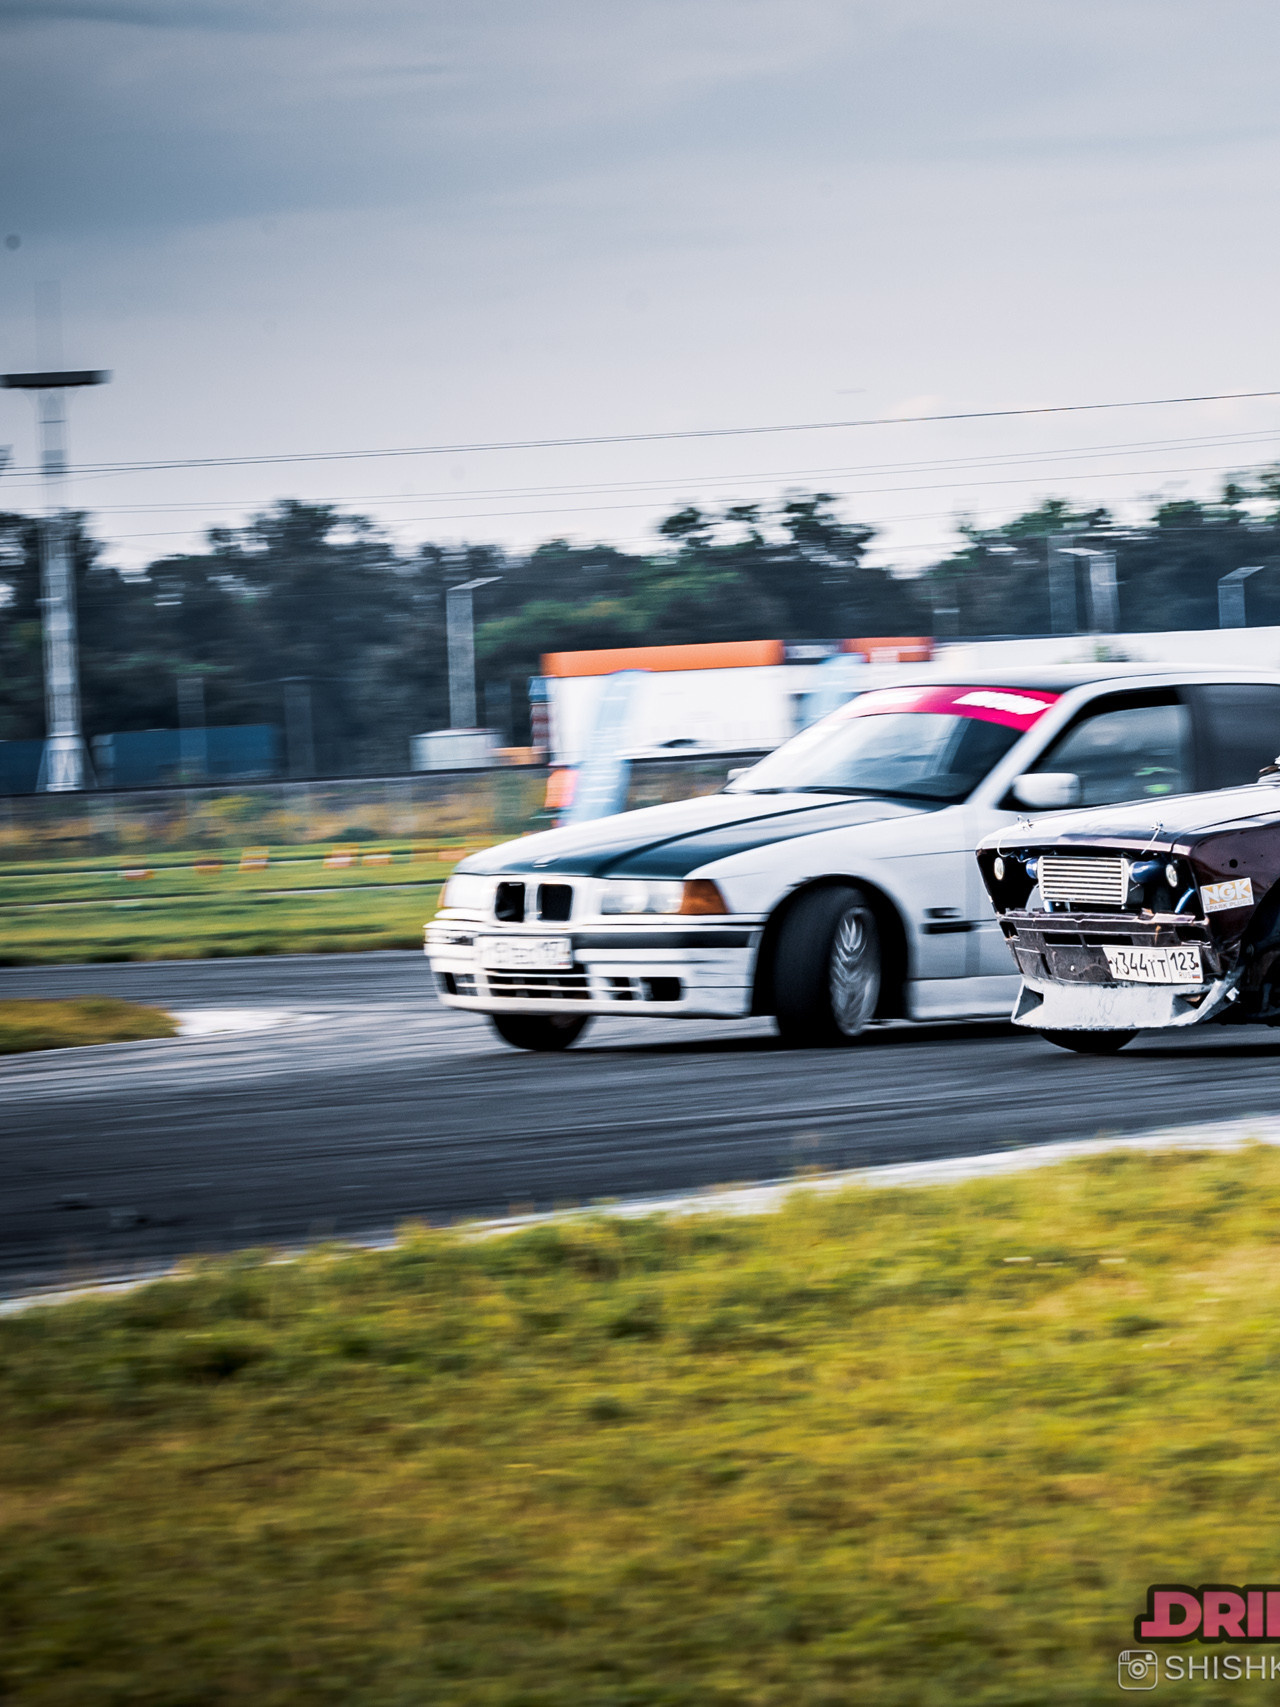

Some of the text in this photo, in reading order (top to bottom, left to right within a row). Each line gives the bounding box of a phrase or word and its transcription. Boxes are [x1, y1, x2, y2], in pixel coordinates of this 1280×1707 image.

[1203, 880, 1251, 905] NGK
[1205, 902, 1229, 912] SPARK
[1170, 951, 1196, 971] 123
